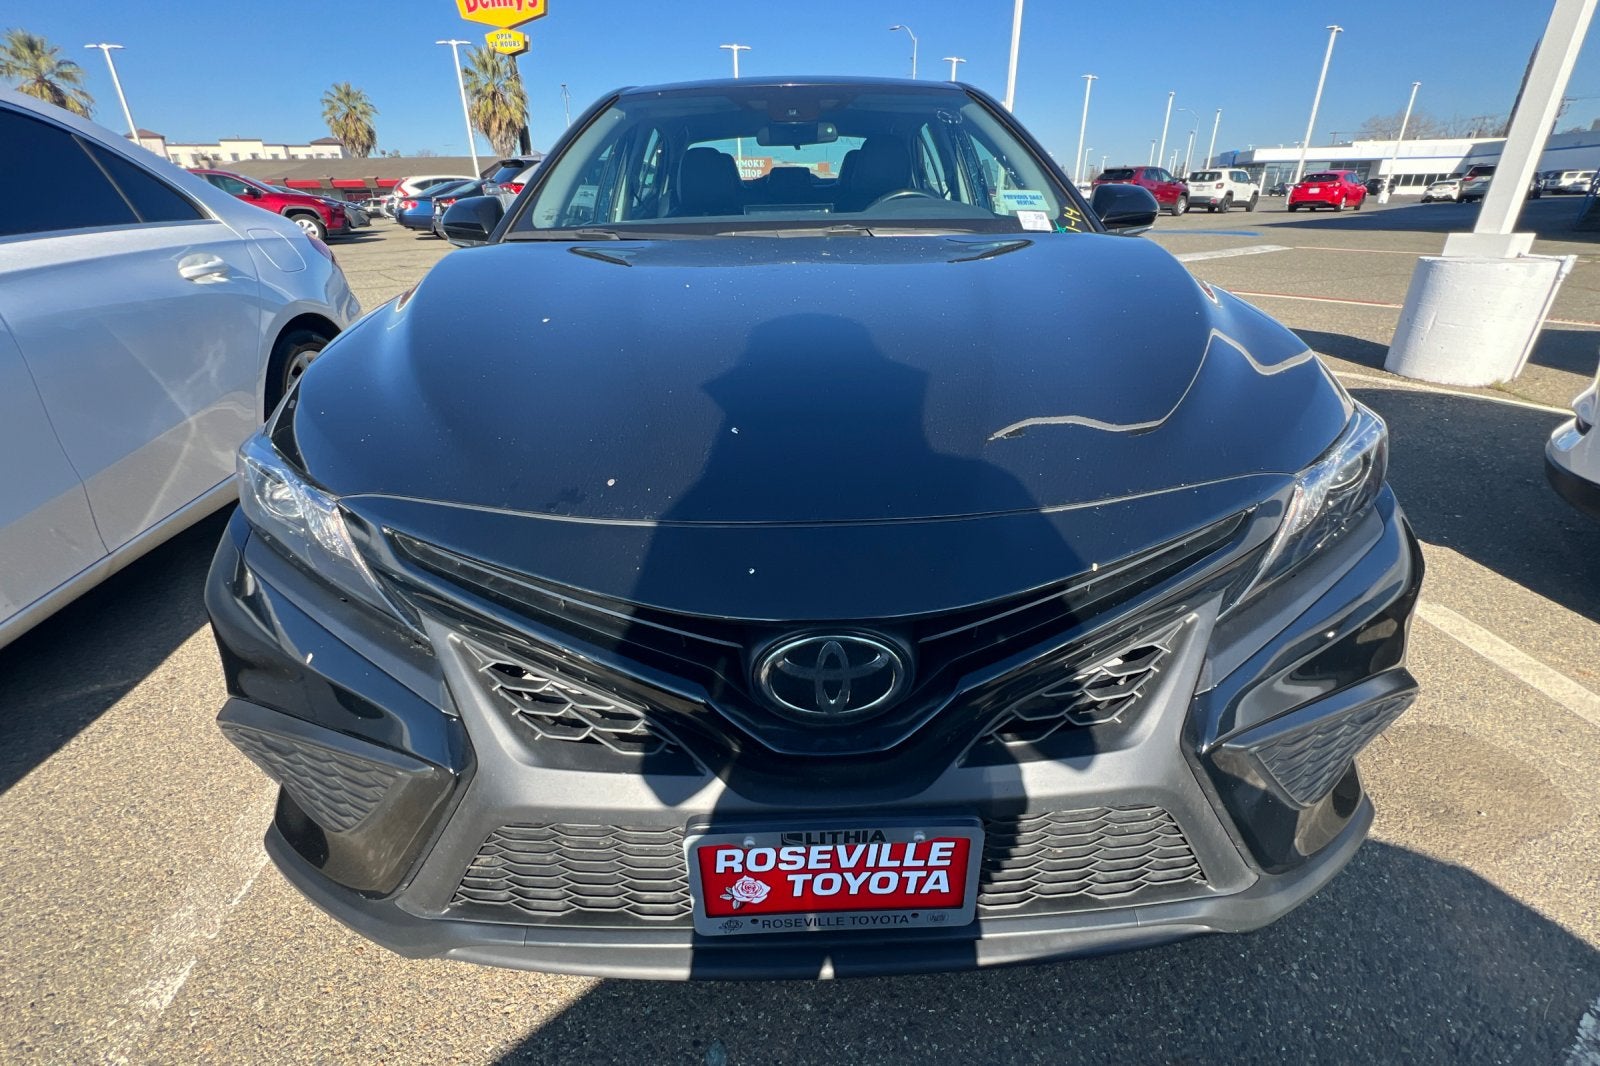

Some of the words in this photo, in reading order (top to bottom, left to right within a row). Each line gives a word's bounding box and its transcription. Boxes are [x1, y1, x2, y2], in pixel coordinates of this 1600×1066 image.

[740, 169, 762, 178] SHOP
[805, 829, 887, 845] LITHIA
[715, 841, 956, 873] ROSEVILLE
[787, 870, 950, 897] TOYOTA
[761, 915, 848, 929] ROSEVILLE
[849, 914, 909, 926] TOYOTA
